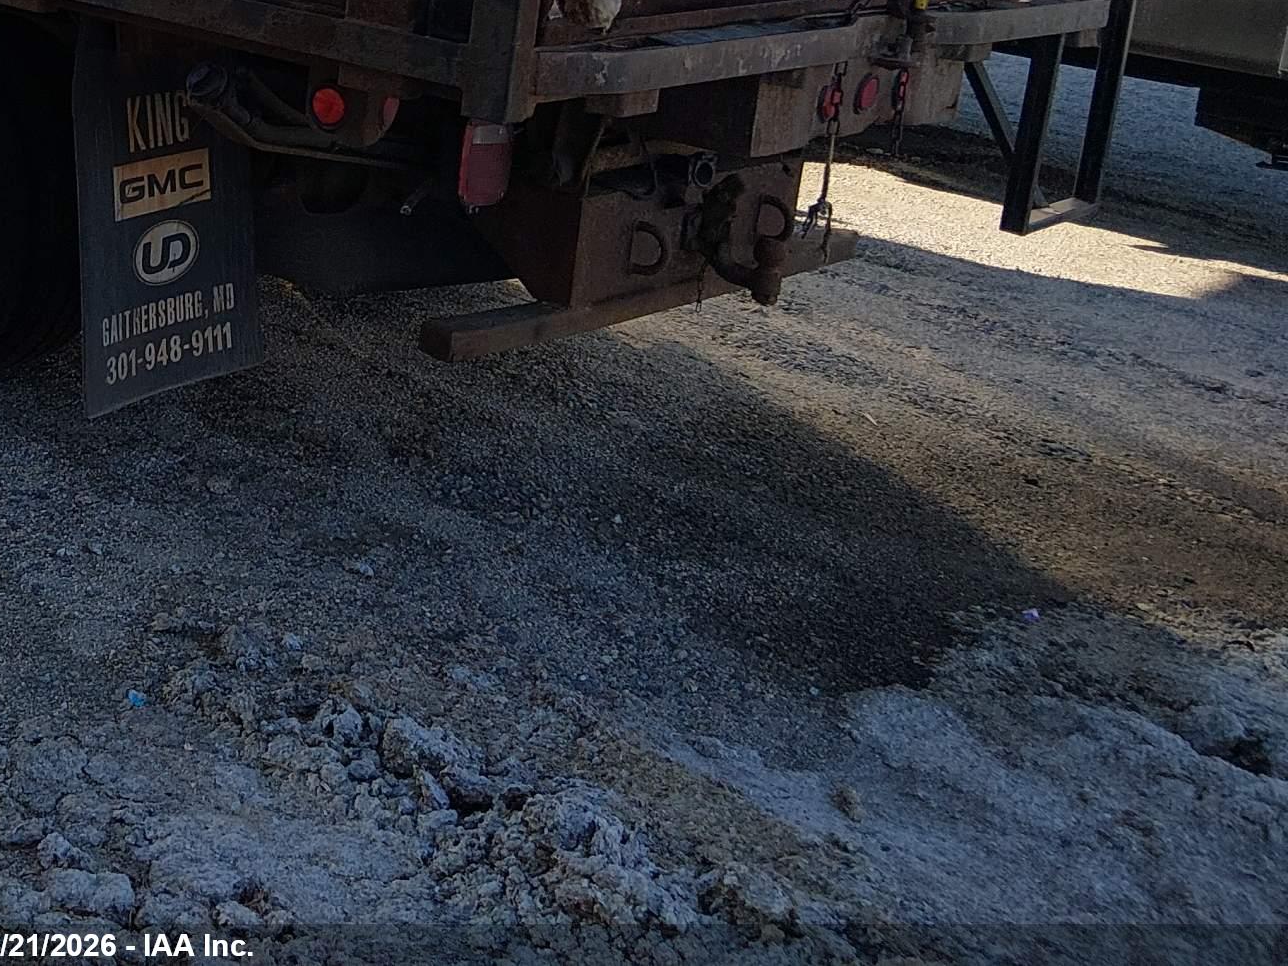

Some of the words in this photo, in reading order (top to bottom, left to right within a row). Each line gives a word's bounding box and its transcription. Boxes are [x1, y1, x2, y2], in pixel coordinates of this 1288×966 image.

[126, 90, 190, 153] KING
[119, 164, 204, 204] GMC
[141, 233, 191, 275] UD
[212, 283, 235, 314] MD
[106, 322, 233, 385] 301-948-9111
